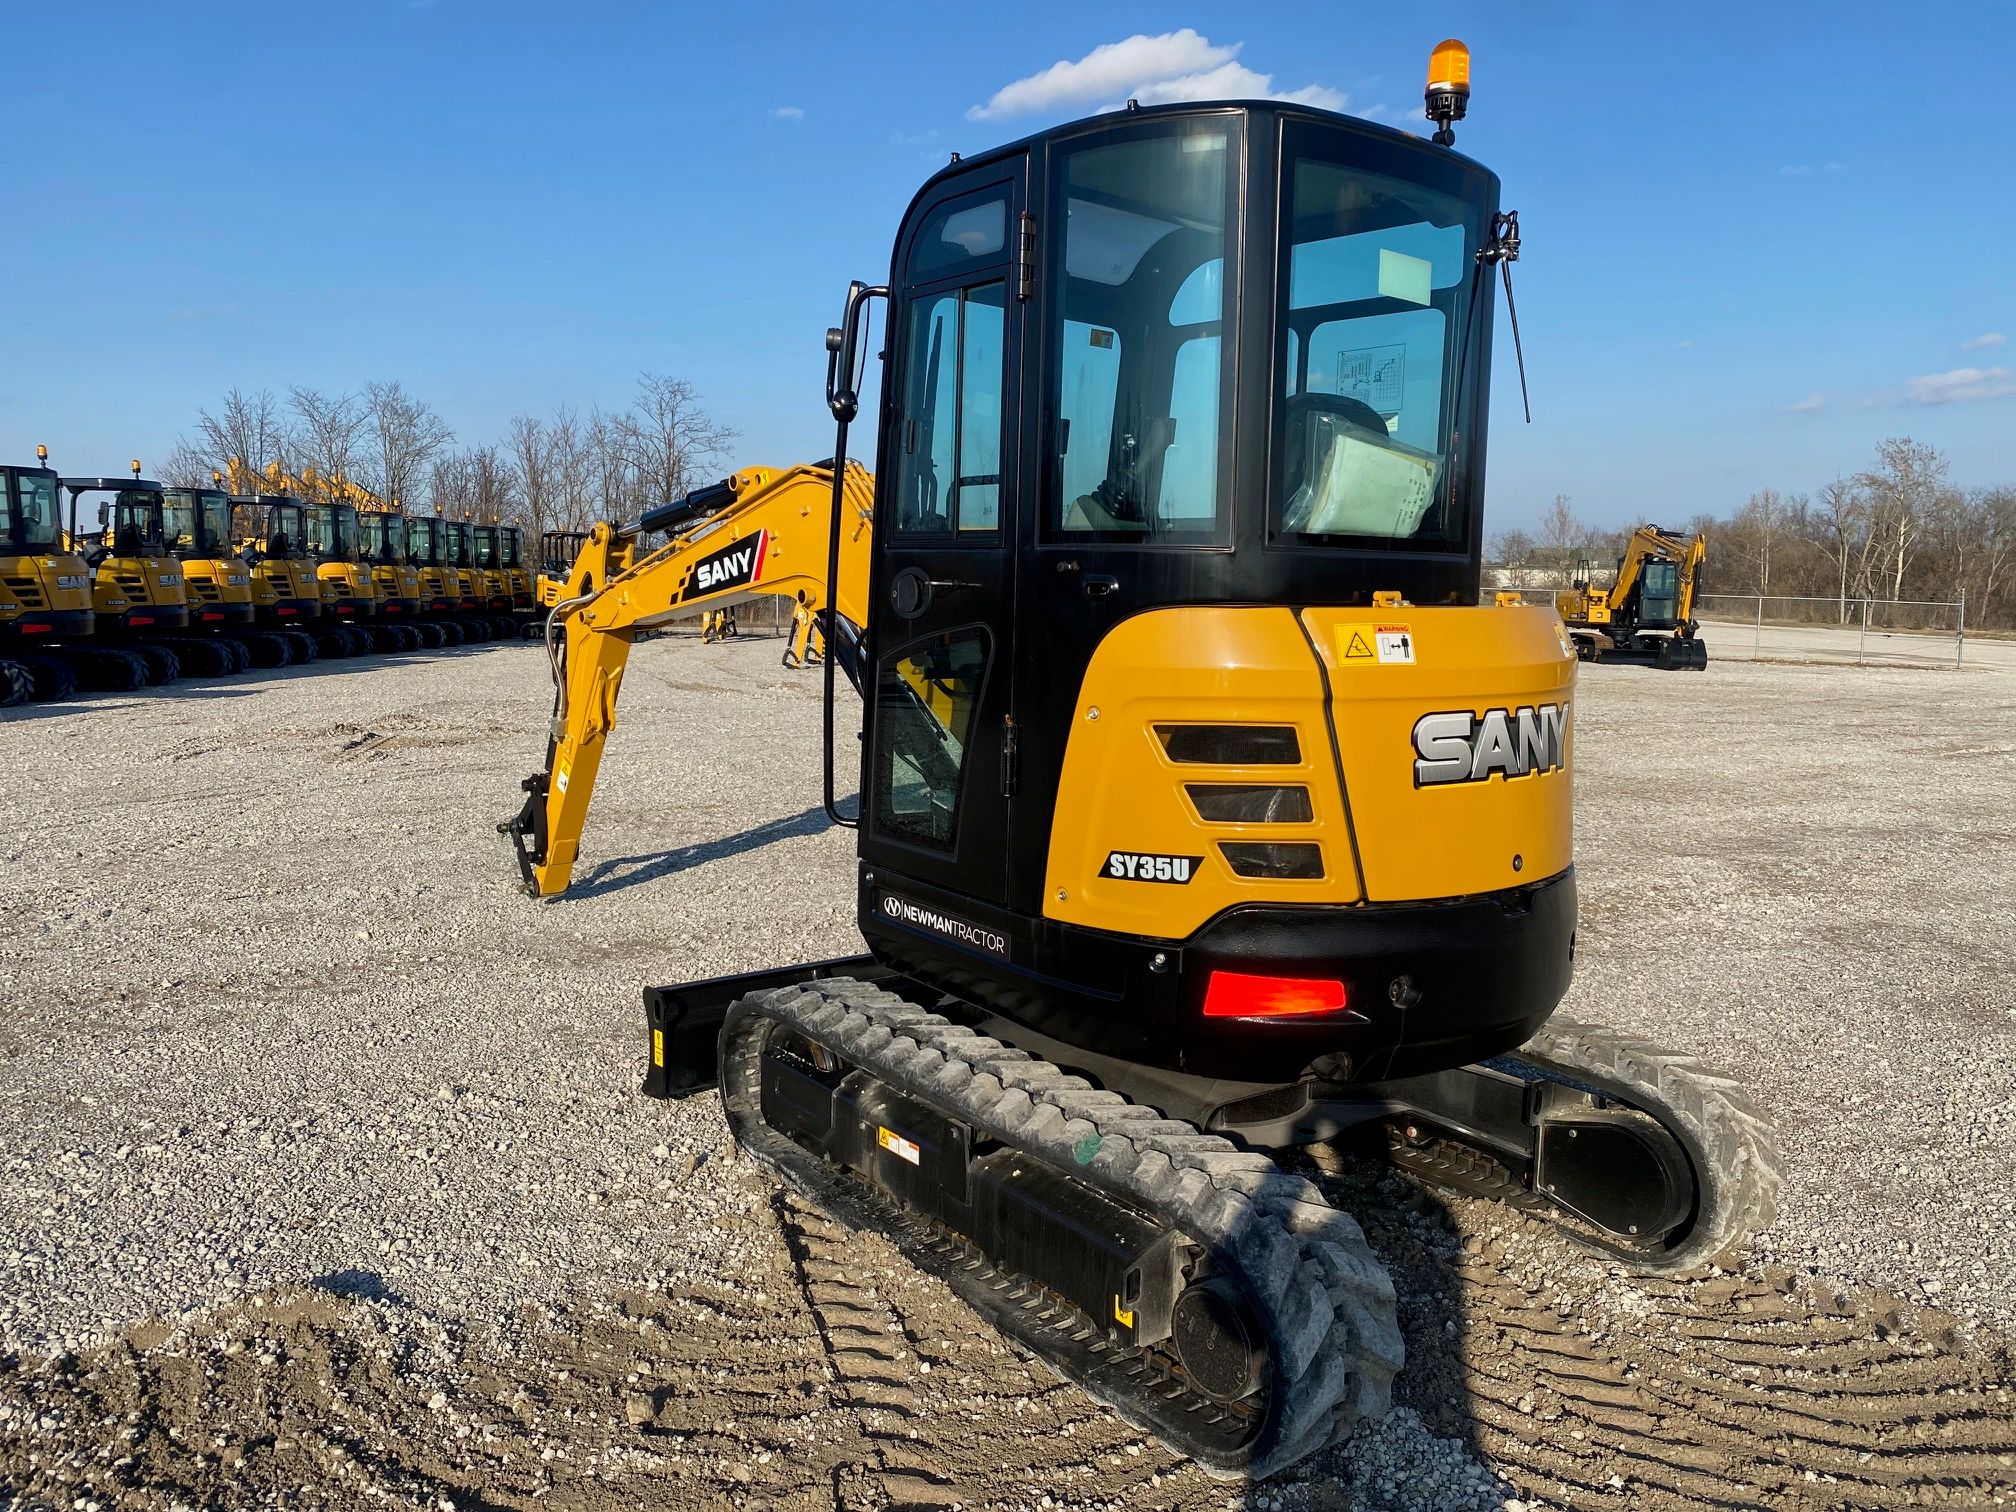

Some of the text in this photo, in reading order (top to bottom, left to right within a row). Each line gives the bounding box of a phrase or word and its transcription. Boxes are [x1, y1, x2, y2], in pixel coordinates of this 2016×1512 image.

[159, 574, 183, 588] SAN
[697, 548, 752, 590] SANY
[1412, 702, 1570, 788] SANY
[1109, 853, 1190, 882] SY35U
